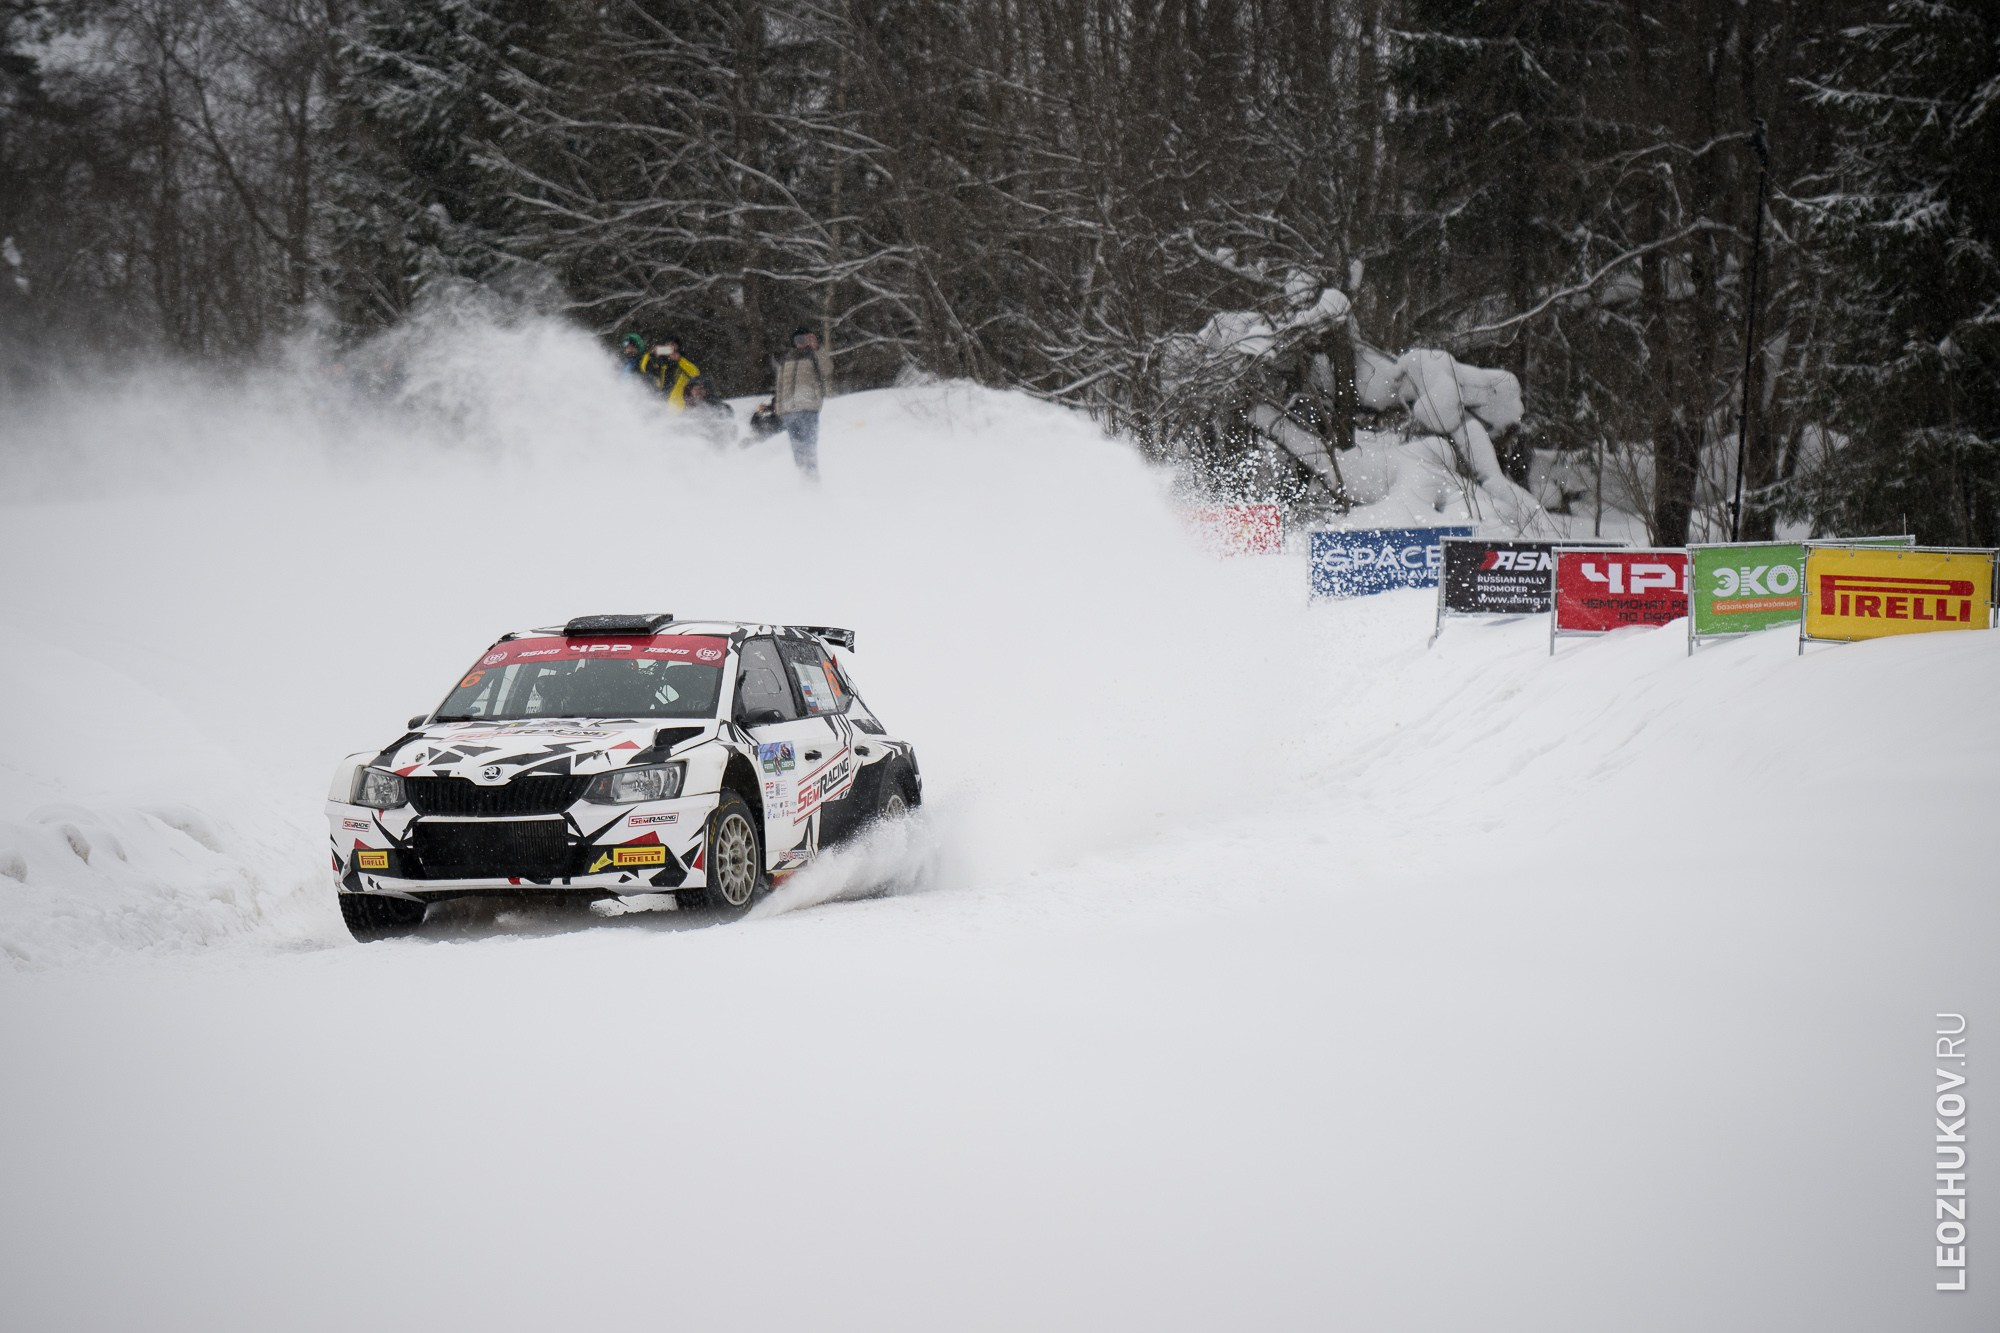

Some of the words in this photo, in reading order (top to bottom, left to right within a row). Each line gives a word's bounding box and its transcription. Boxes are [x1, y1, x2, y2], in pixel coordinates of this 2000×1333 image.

[1477, 575, 1516, 583] RUSSIAN
[1519, 576, 1546, 584] RALLY
[1582, 563, 1688, 594] ЧР
[1712, 564, 1804, 597] ЭКО
[1477, 585, 1528, 593] PROMOTER
[1581, 599, 1665, 610] ЧЕМПИОНАТ
[1820, 574, 1975, 622] PIRELLI
[460, 671, 486, 688] 6
[823, 660, 841, 698] 6
[630, 814, 677, 825] SEMRACING
[360, 855, 385, 866] PIRELLI
[618, 850, 661, 863] PIRELLI
